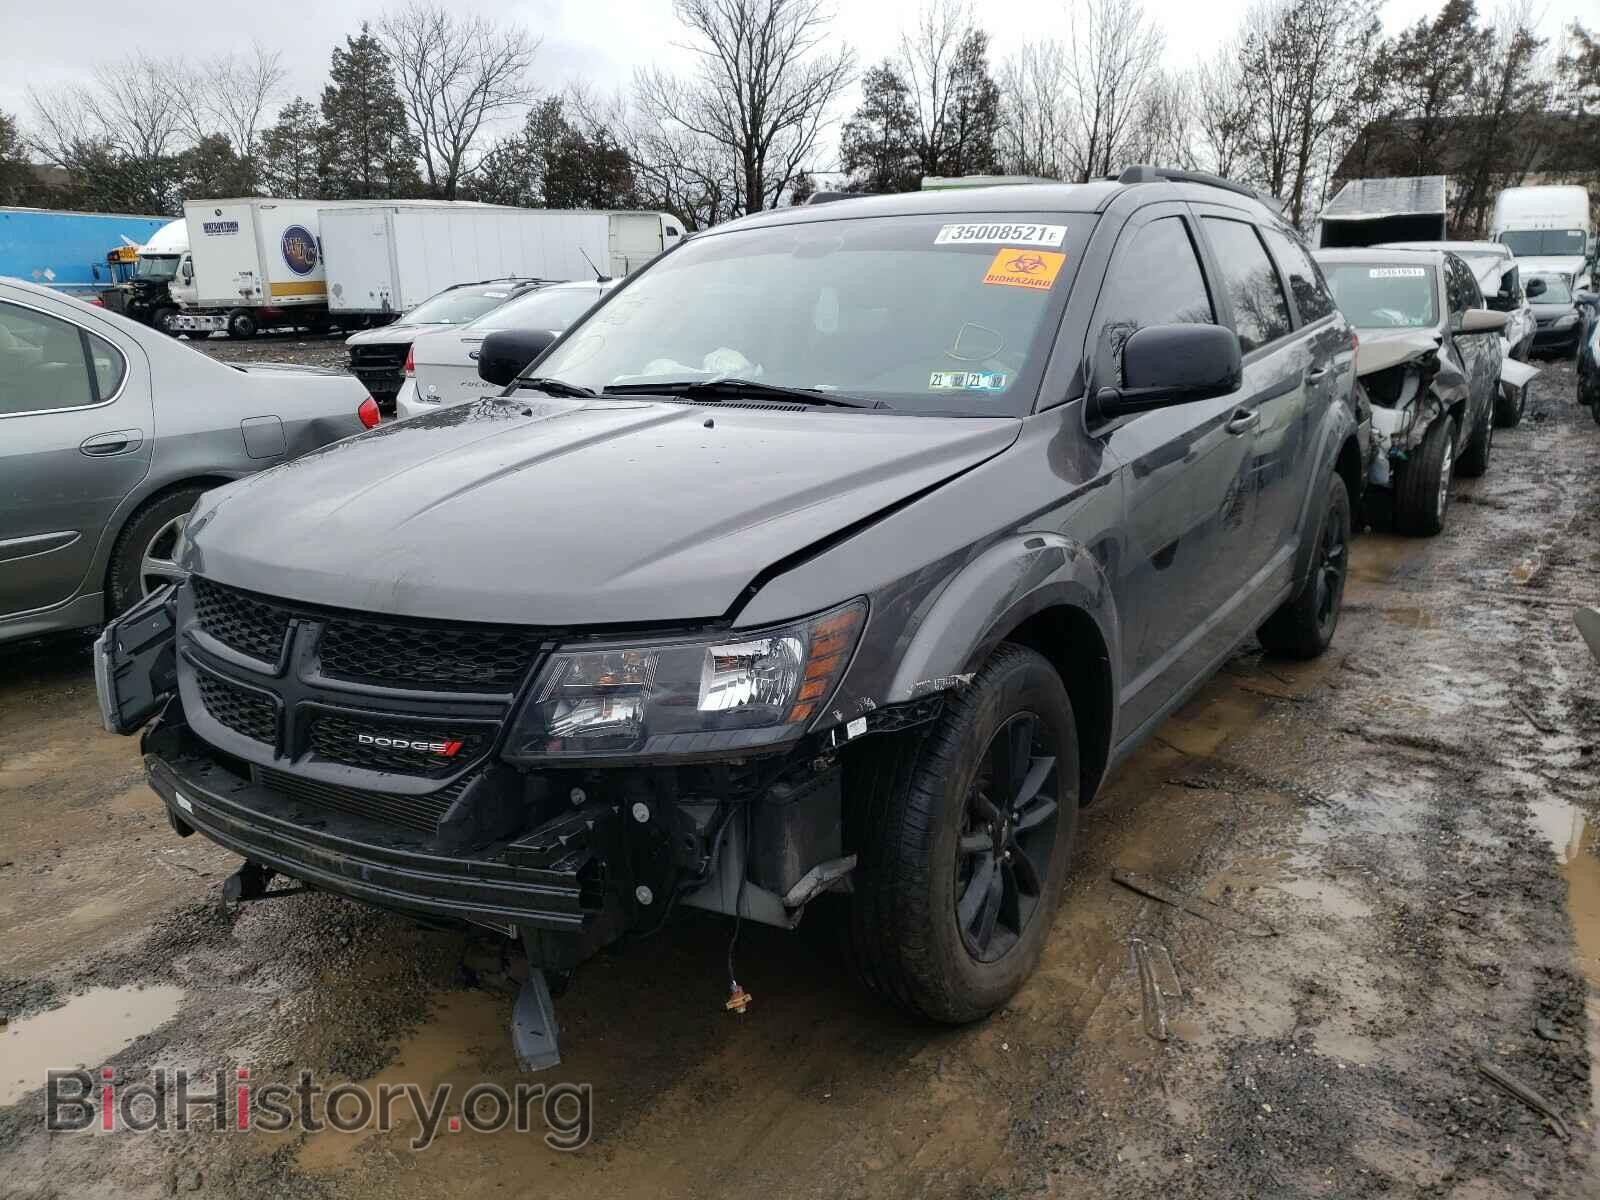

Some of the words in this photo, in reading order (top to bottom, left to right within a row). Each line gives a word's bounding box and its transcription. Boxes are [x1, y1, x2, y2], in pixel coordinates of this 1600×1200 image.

[951, 225, 1047, 241] 35008521
[986, 274, 1051, 287] BIOHAZARD
[931, 374, 943, 386] 21
[970, 374, 981, 387] 21
[358, 734, 448, 752] DODGE
